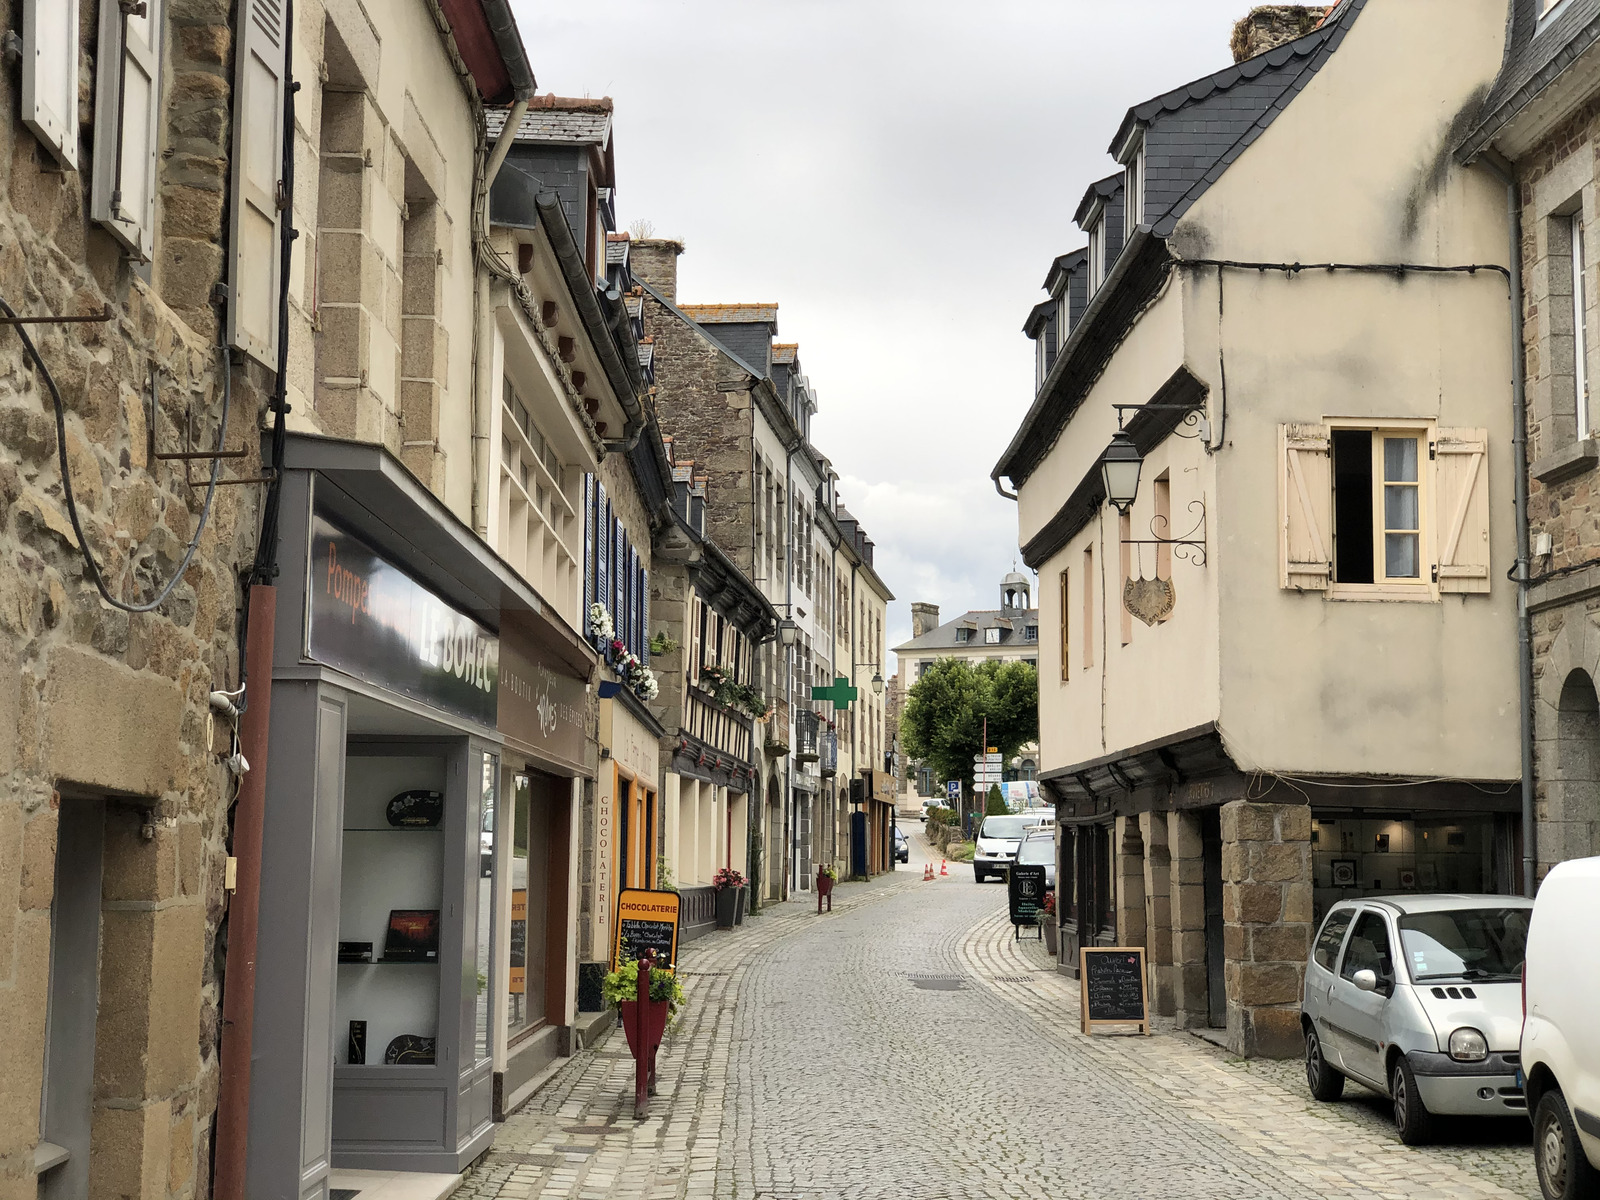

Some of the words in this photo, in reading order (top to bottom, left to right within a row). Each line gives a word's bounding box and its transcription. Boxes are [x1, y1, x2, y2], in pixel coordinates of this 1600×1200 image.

[419, 601, 440, 667] LE
[442, 616, 492, 693] BOHEC
[598, 795, 609, 924] CHOCOLATERIE
[620, 902, 678, 913] CHOCOLATERIE
